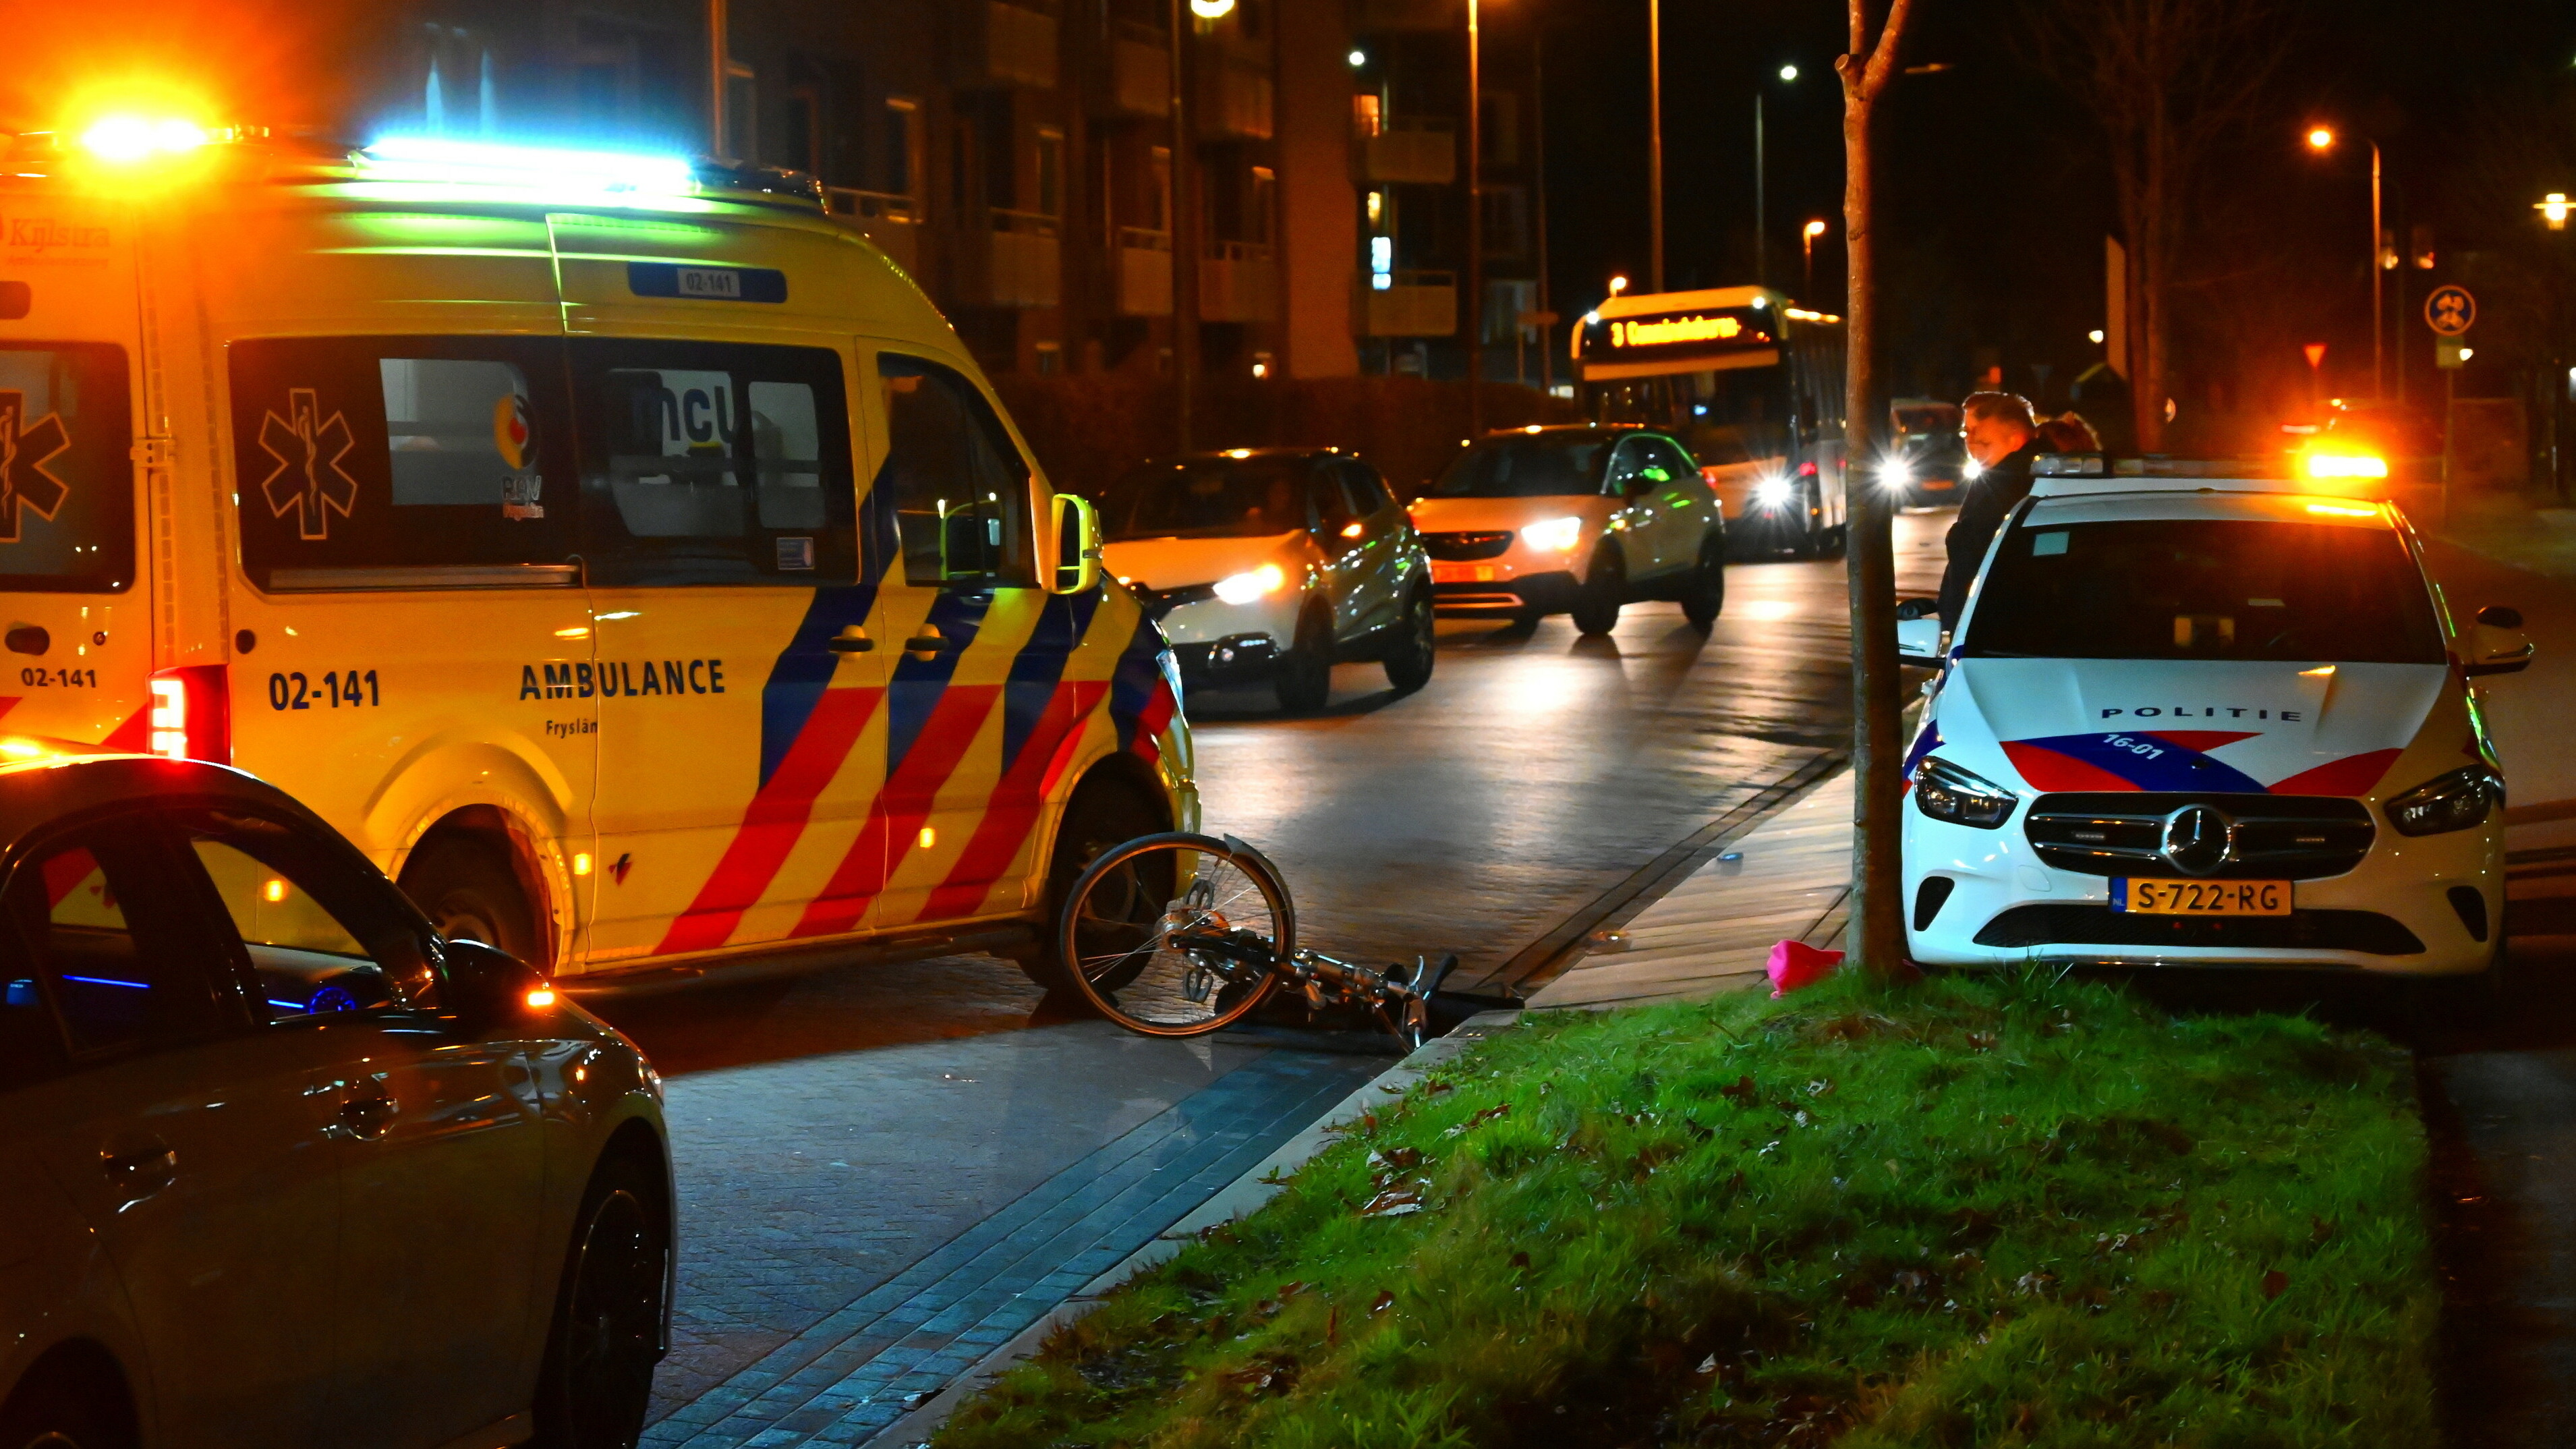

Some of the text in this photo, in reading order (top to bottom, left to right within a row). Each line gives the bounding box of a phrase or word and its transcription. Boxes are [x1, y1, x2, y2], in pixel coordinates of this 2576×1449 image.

[686, 273, 732, 292] 02-141
[21, 667, 96, 687] 02-141
[519, 660, 725, 700] AMBULANCE
[269, 669, 378, 711] 02-141
[2101, 706, 2301, 722] POLITIE
[546, 718, 598, 739] Fryslân
[2102, 734, 2165, 760] 16-01
[2112, 897, 2125, 907] NL
[2138, 882, 2279, 911] S-722-RG
